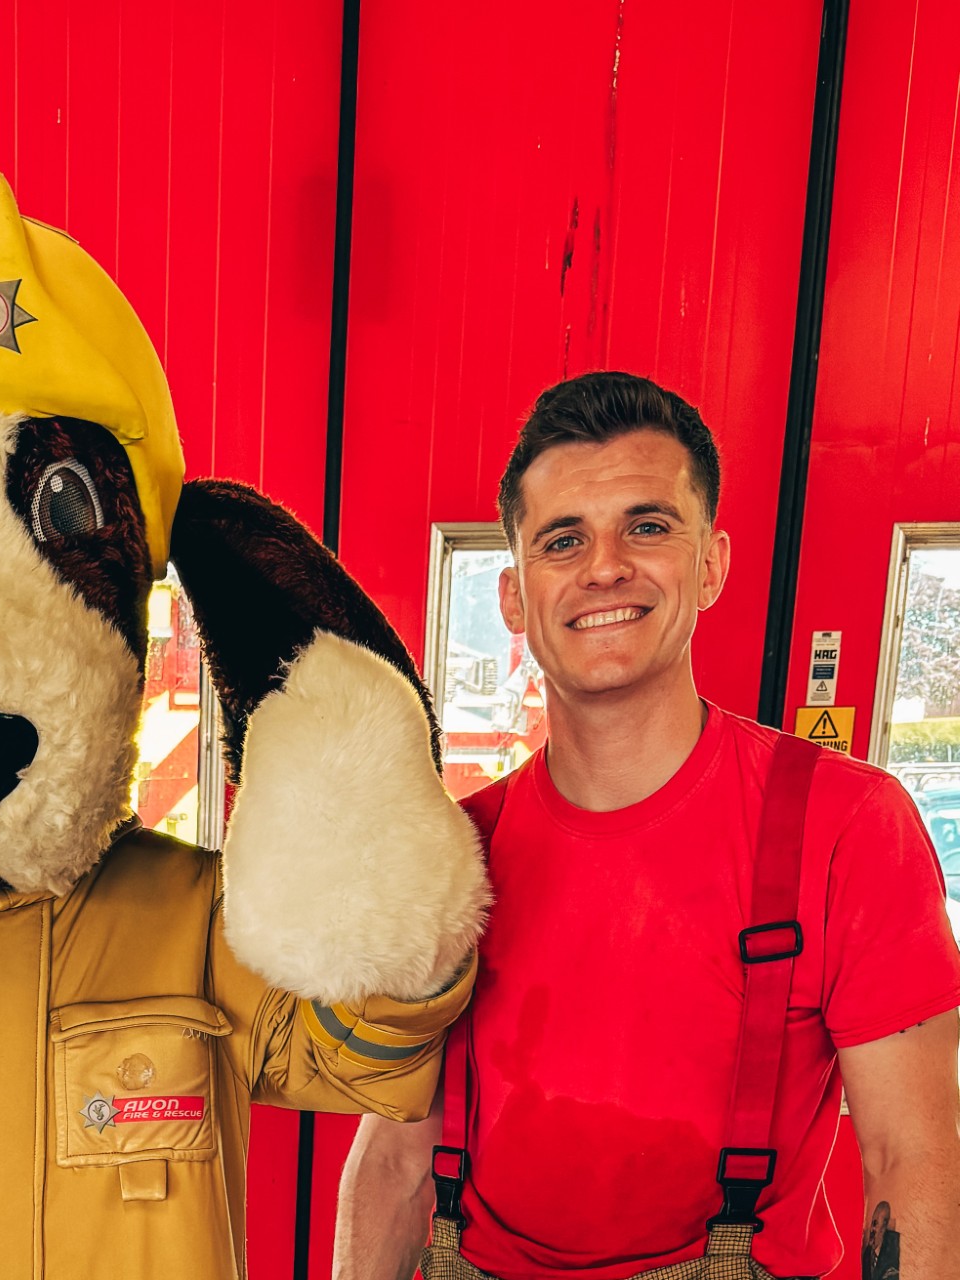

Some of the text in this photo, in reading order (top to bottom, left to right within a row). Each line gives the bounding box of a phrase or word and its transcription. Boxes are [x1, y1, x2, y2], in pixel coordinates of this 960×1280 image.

[816, 740, 848, 751] NING
[124, 1099, 179, 1112] AVON
[123, 1111, 149, 1119] FIRE
[152, 1110, 160, 1118] &
